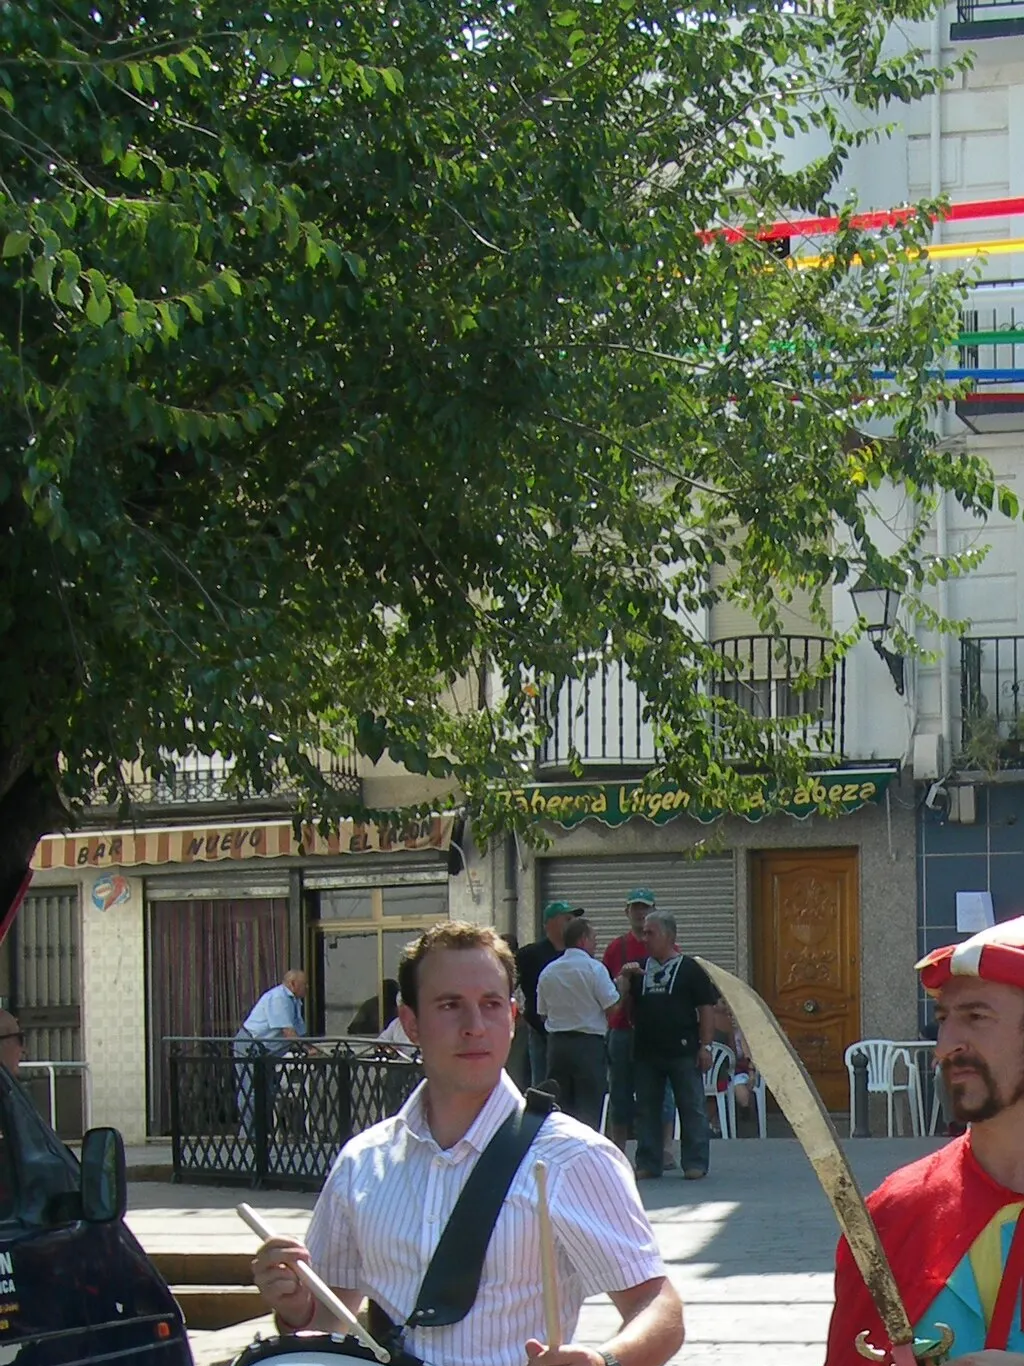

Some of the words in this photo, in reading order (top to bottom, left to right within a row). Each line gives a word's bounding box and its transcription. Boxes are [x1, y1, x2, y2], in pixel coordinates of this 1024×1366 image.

[779, 777, 877, 806] cabeza
[77, 838, 123, 865] BAR
[187, 829, 263, 856] NUEVO
